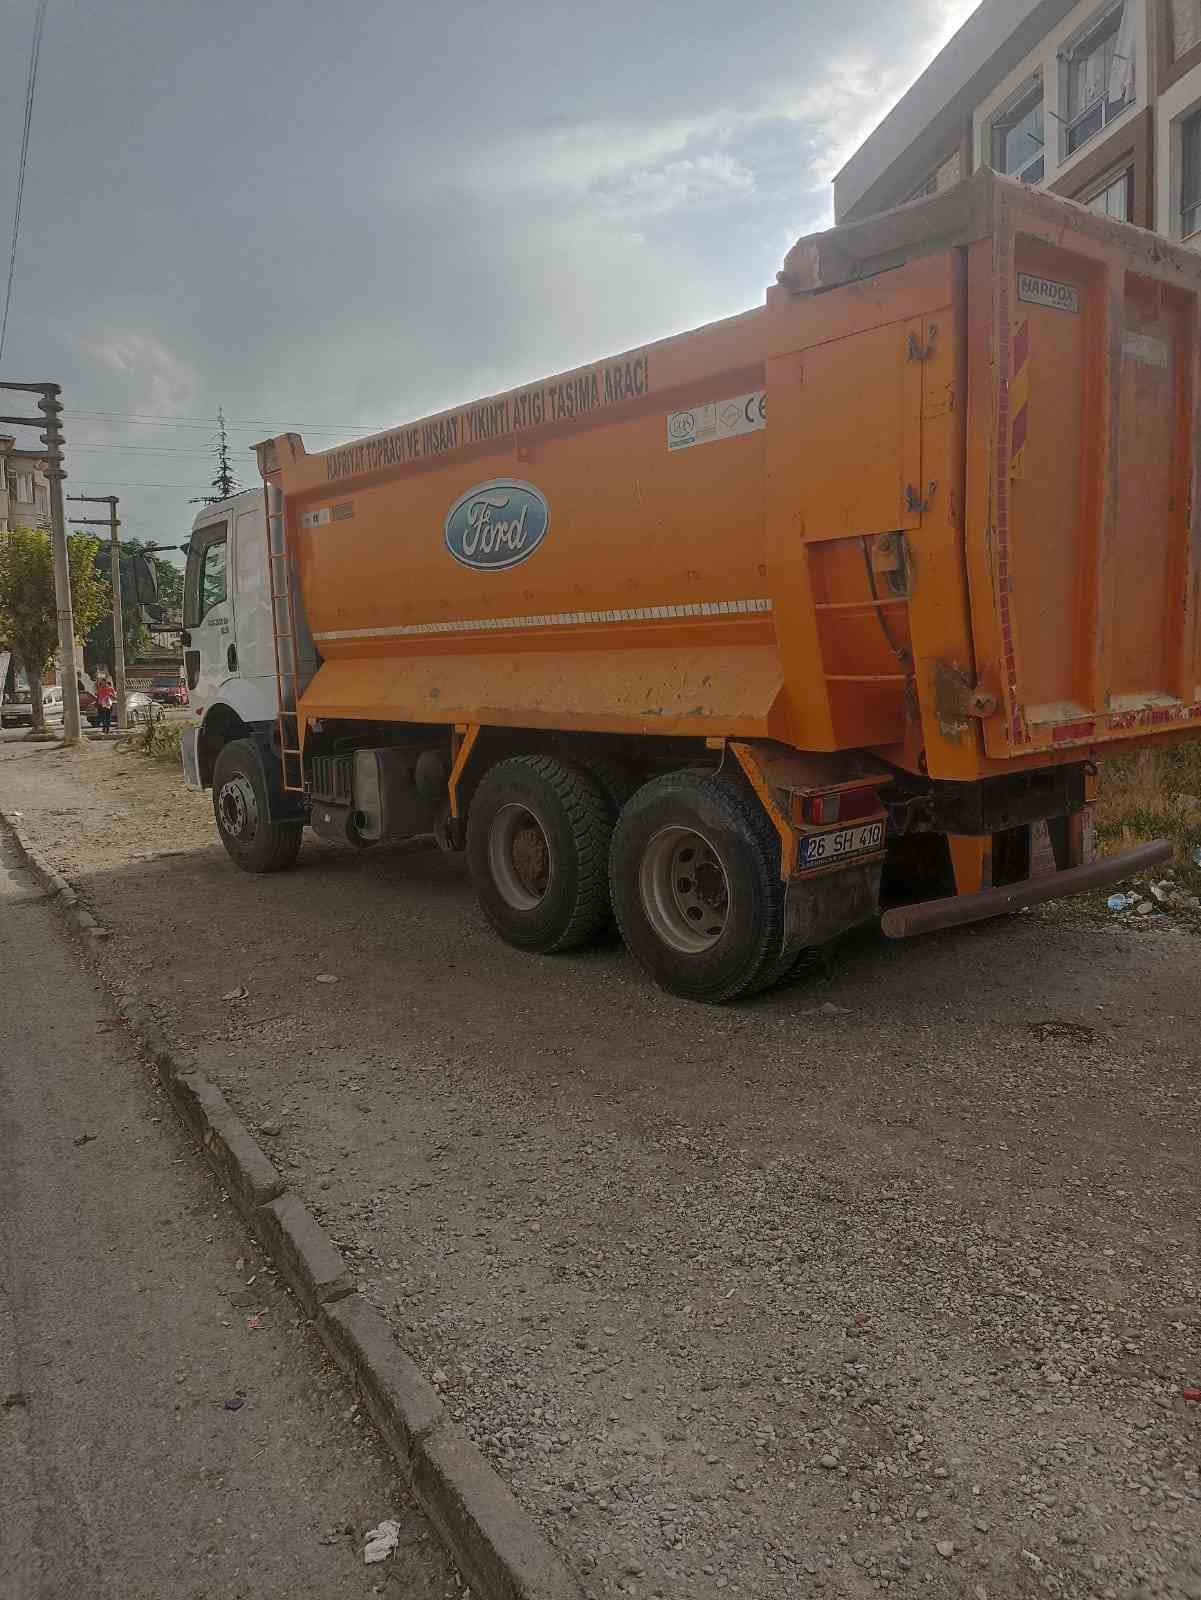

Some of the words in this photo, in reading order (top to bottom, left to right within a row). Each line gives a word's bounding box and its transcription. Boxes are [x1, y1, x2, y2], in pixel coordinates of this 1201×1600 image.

[1021, 278, 1075, 302] HARDOX
[406, 429, 419, 460] VE
[463, 495, 528, 555] Ford
[807, 838, 826, 859] 26
[833, 831, 853, 852] SH
[860, 825, 881, 846] 410
